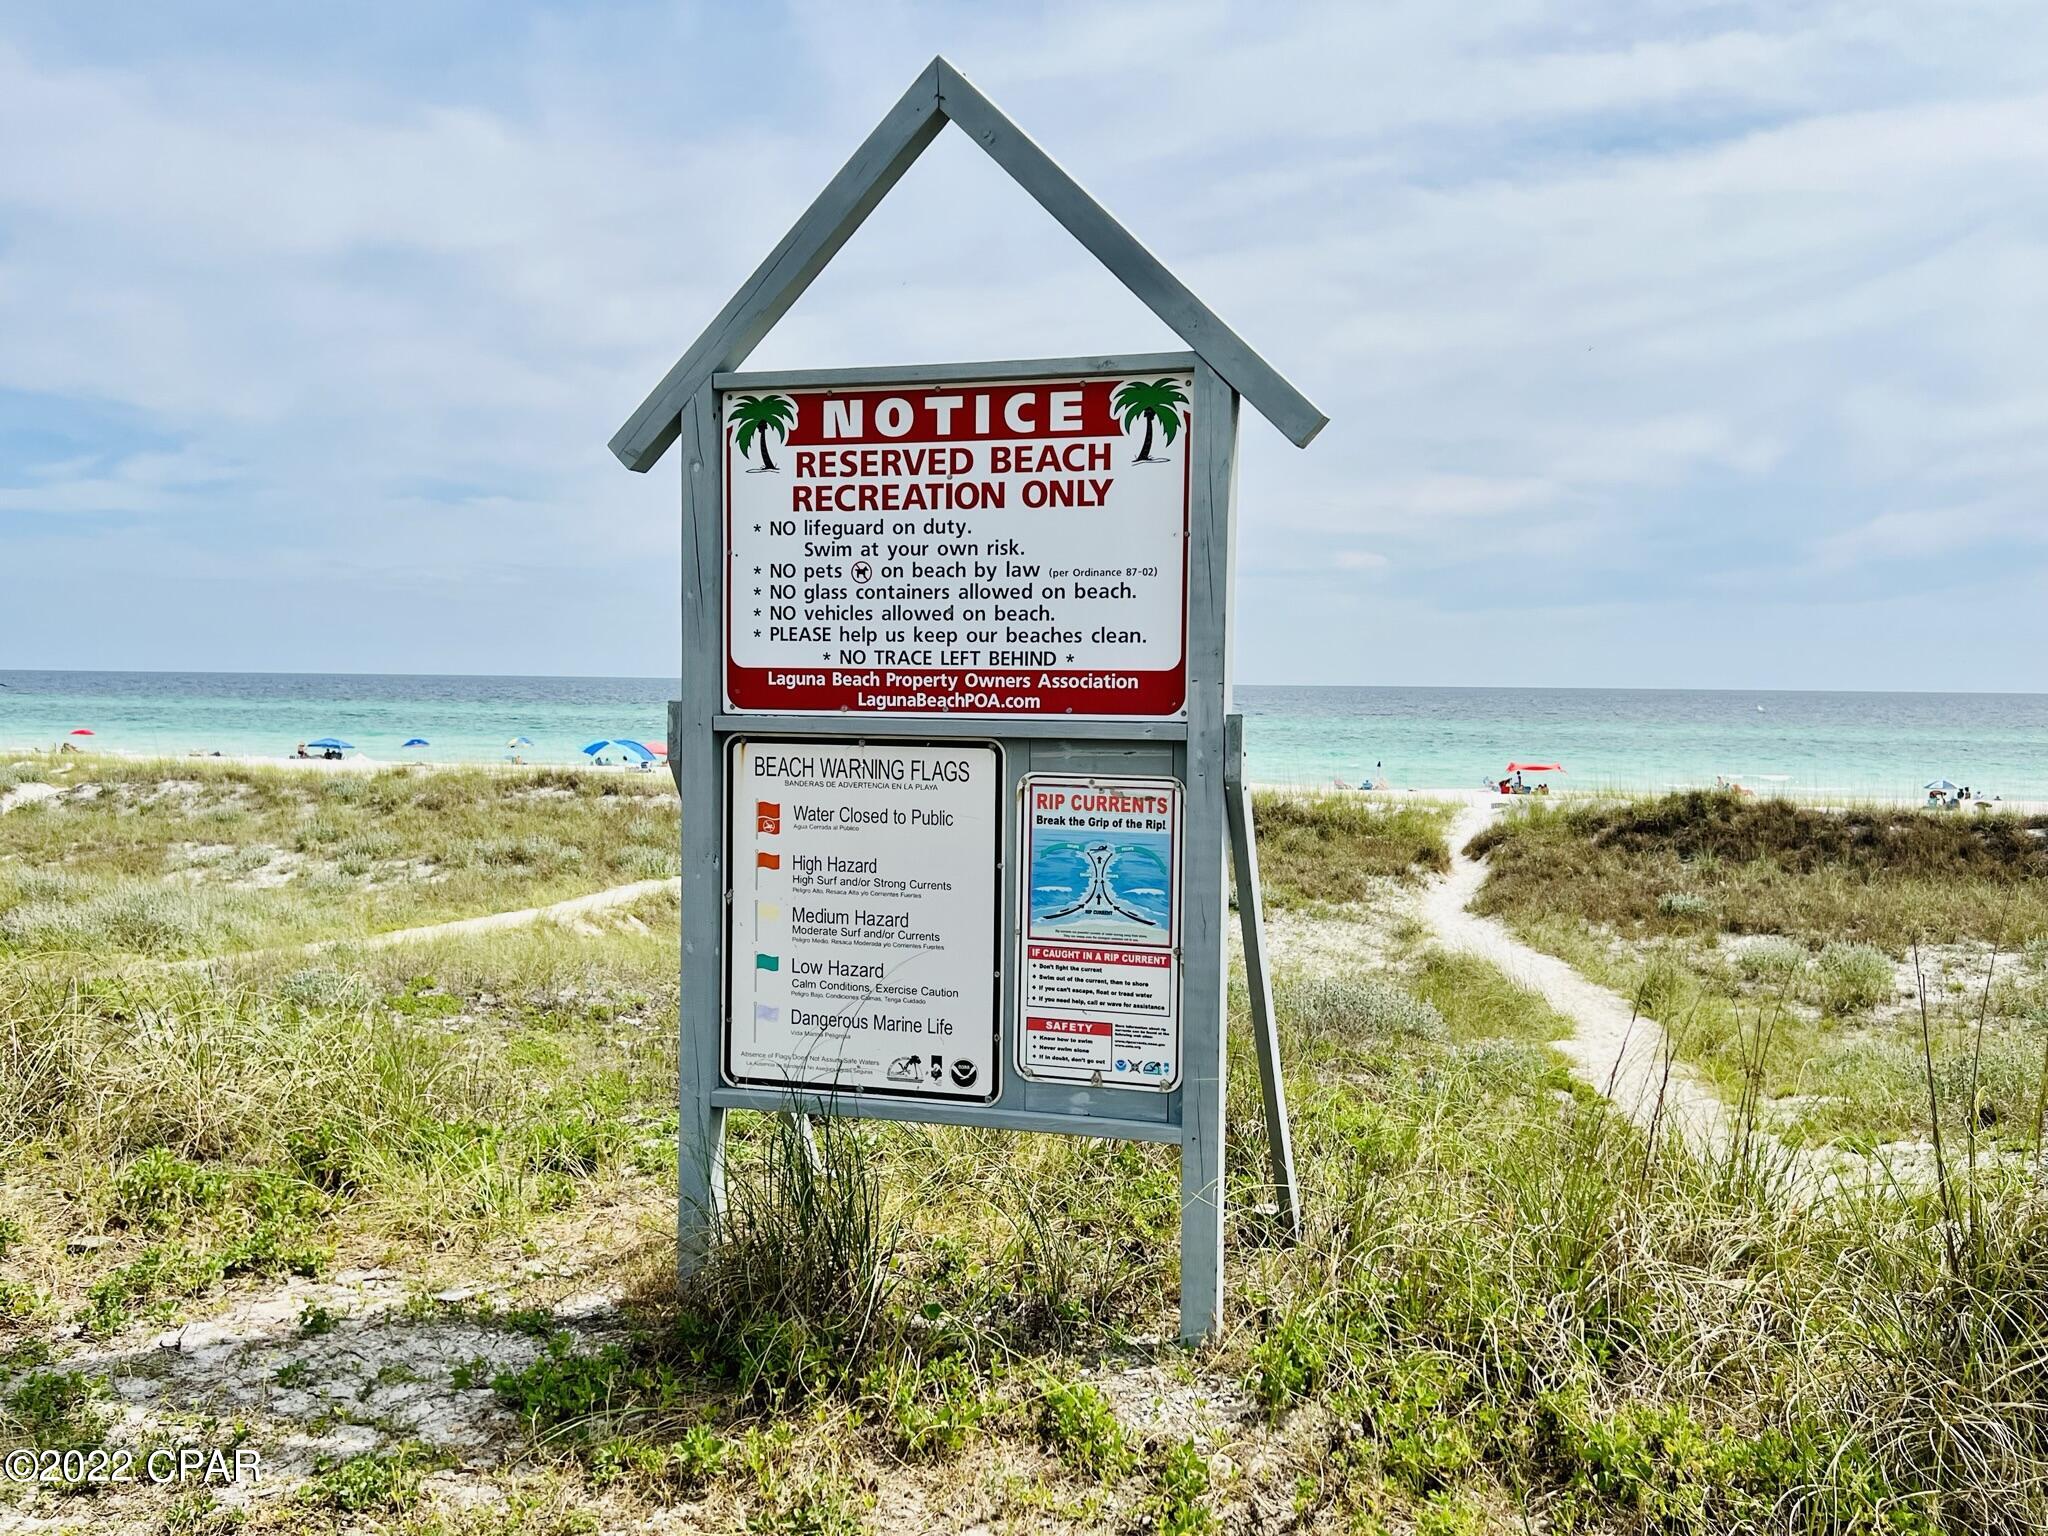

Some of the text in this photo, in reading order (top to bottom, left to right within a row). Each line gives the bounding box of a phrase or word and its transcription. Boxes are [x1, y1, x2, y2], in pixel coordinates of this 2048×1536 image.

[823, 391, 1082, 438] NOTICE
[796, 443, 1110, 478] RESERVED BEACH
[793, 478, 1113, 511] RECREATION ONLY
[770, 519, 970, 539] NO lifeguard on duty.
[804, 539, 1024, 560] Swim at your own risk.
[770, 560, 1157, 582] NO pets on beach by law (per Ordinance 87-02)
[770, 582, 1135, 603] NO glass containers allowed on beach.
[770, 604, 1054, 621] NO vehicles allowed on beach.
[770, 626, 1146, 646] PLEASE help us keep our beaches clean.
[840, 650, 1056, 666] NO TRACE LEFT BEHIND
[768, 671, 1138, 690] Laguna Beach Property Owners Association
[858, 692, 1040, 710] LagunaBeachPOA.com
[755, 756, 969, 782] BEACH WARNING FLAGS
[784, 779, 938, 791] BANDERAS DE ADVERTENCIA EN LA PLAYA
[1037, 793, 1167, 814] RIP CURRENTS
[793, 805, 953, 826] Water Closed to Public
[1036, 815, 1165, 831] Break the Grip of the Rip!
[793, 855, 876, 873] High Hazard
[792, 875, 951, 890] High Surf and/or Strong Currents
[792, 907, 908, 927] Medium Hazard
[792, 925, 940, 941] Moderate Surf and/or Currents
[1032, 947, 1166, 964] IF CAUGHT IN A RIP CURRENT
[792, 958, 883, 978] Low Hazard
[1039, 962, 1054, 970] Don't
[1055, 964, 1069, 972] fight
[1080, 966, 1103, 974] current
[791, 979, 958, 997] Calm Conditions, Exercise Caution
[1039, 973, 1055, 981] Swim
[1085, 978, 1109, 986] current,
[1132, 980, 1149, 988] shore
[1072, 987, 1095, 996] escape,
[1096, 988, 1109, 996] float
[1118, 990, 1134, 998] tread
[1072, 997, 1086, 1006] help,
[1133, 1003, 1165, 1011] assistance
[791, 1009, 952, 1035] Dangerous Marine Life
[1046, 1021, 1092, 1032] SAFETY
